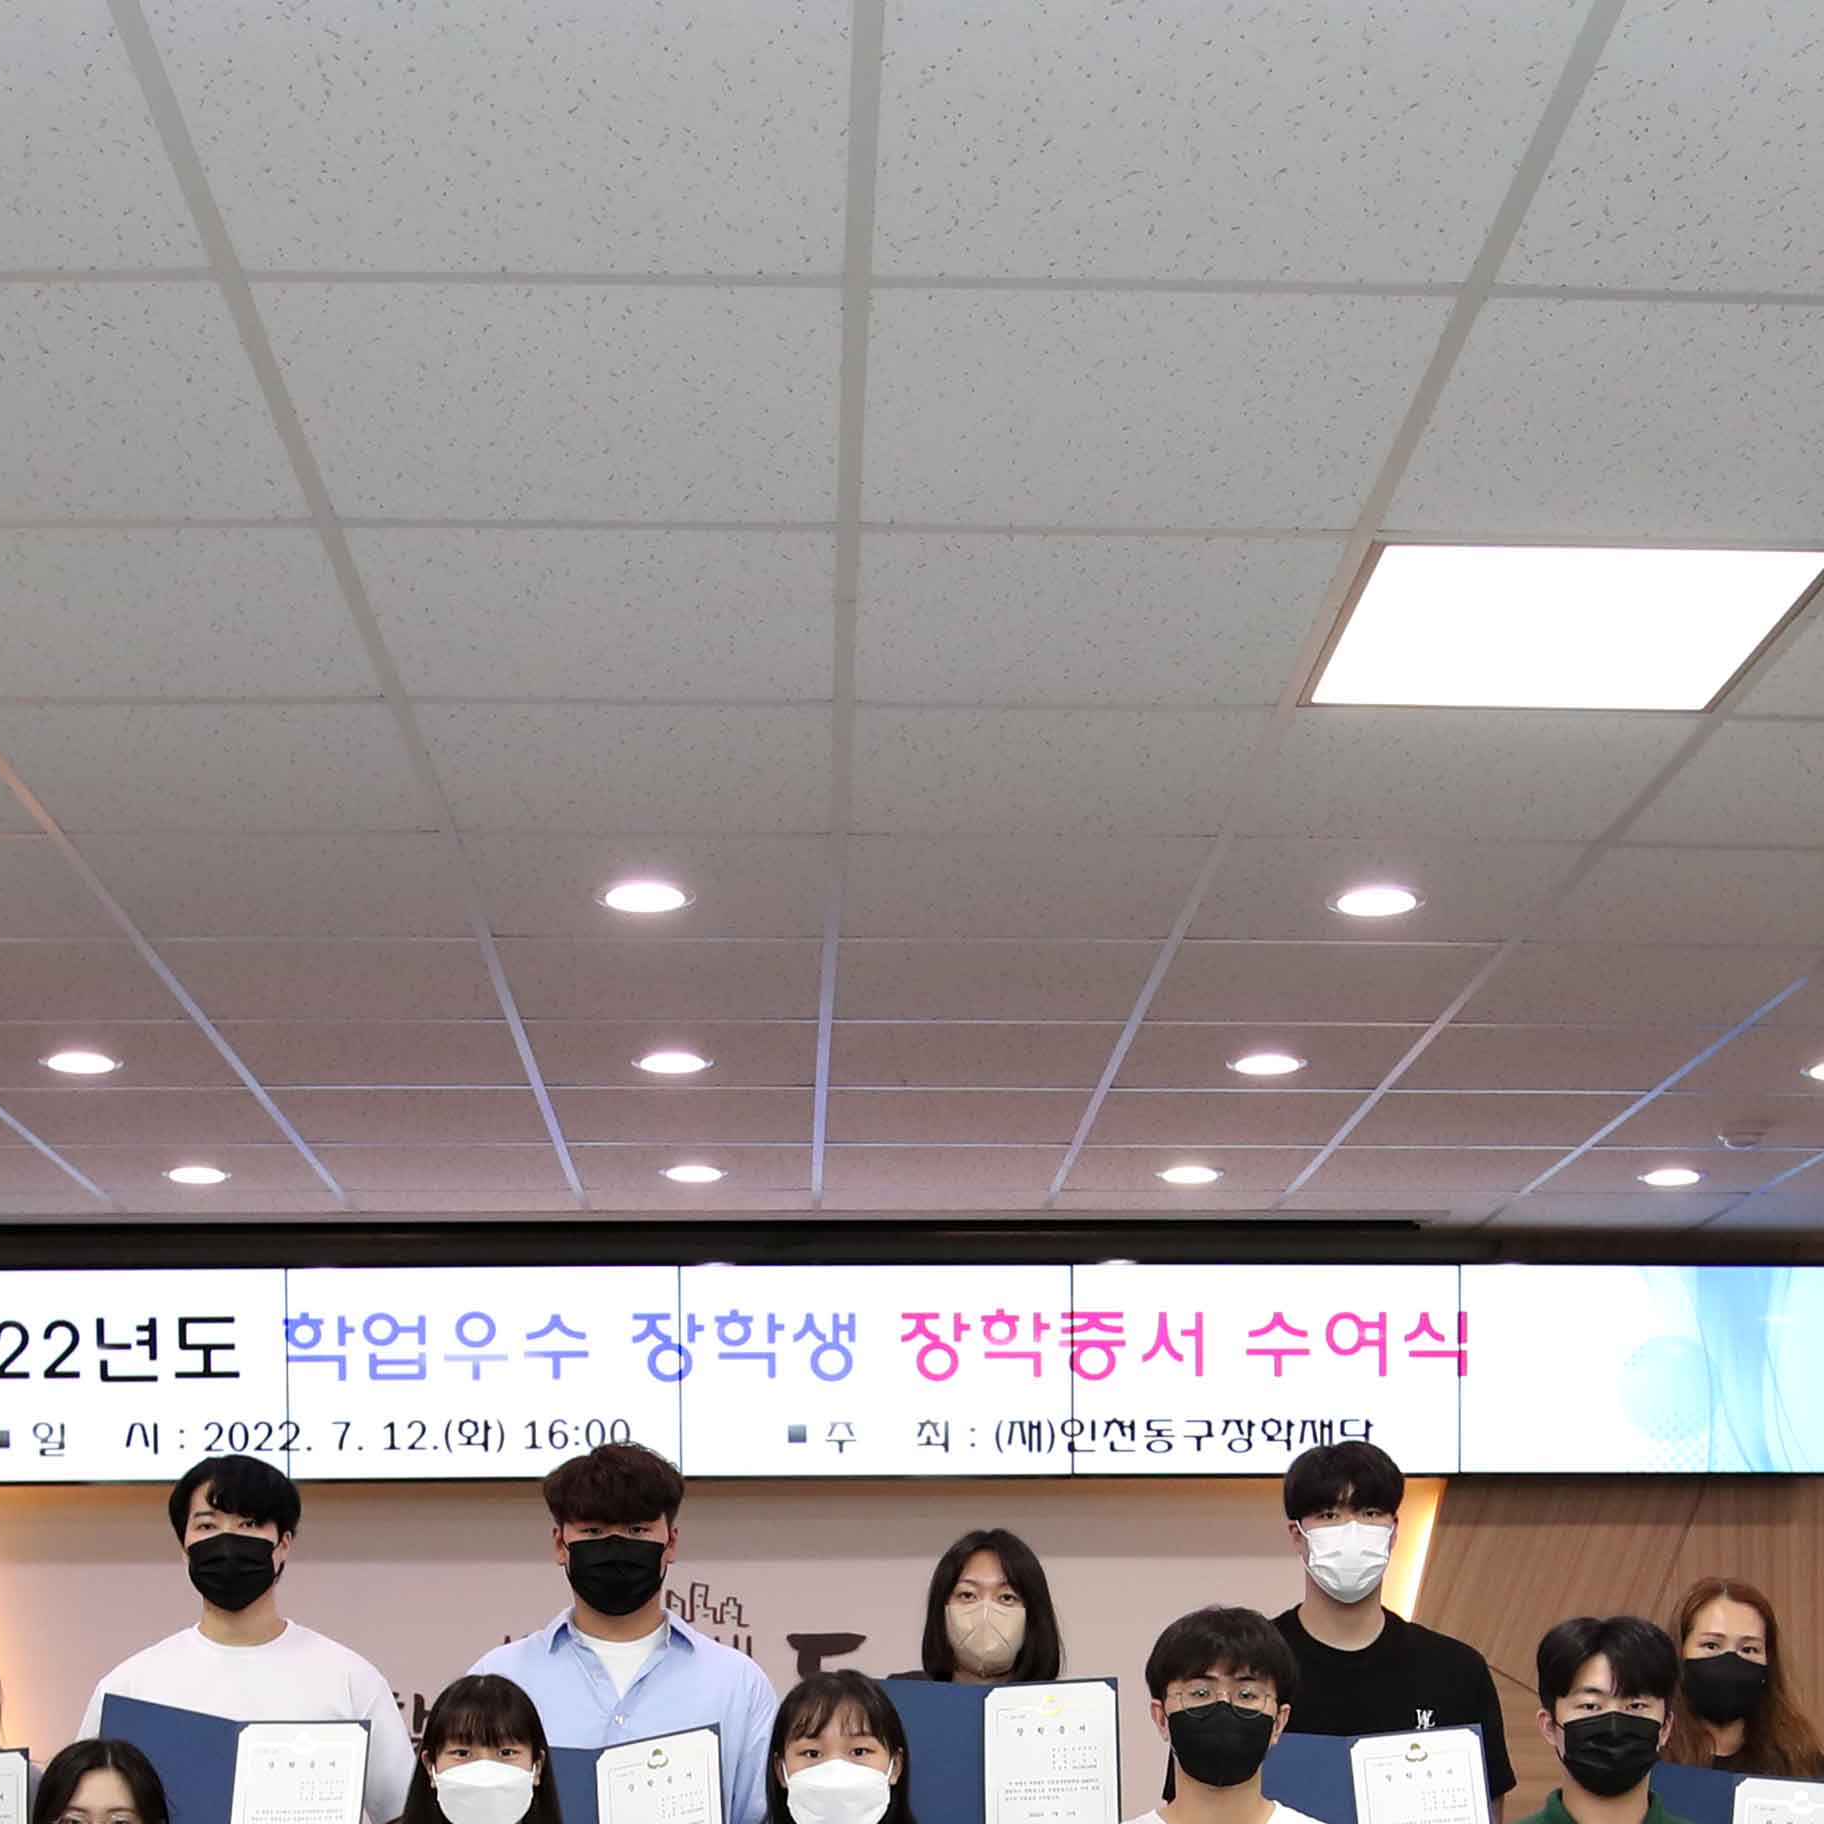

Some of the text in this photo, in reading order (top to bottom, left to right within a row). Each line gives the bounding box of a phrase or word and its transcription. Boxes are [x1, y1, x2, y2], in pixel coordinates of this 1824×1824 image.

[282, 1311, 589, 1382] 학업우수
[631, 1308, 857, 1383] 장학생
[900, 1307, 1204, 1381] 장학증서
[1245, 1311, 1468, 1377] 수여식
[202, 1420, 313, 1452] 2022.
[331, 1420, 364, 1451] 7.
[523, 1418, 631, 1451] 16:00
